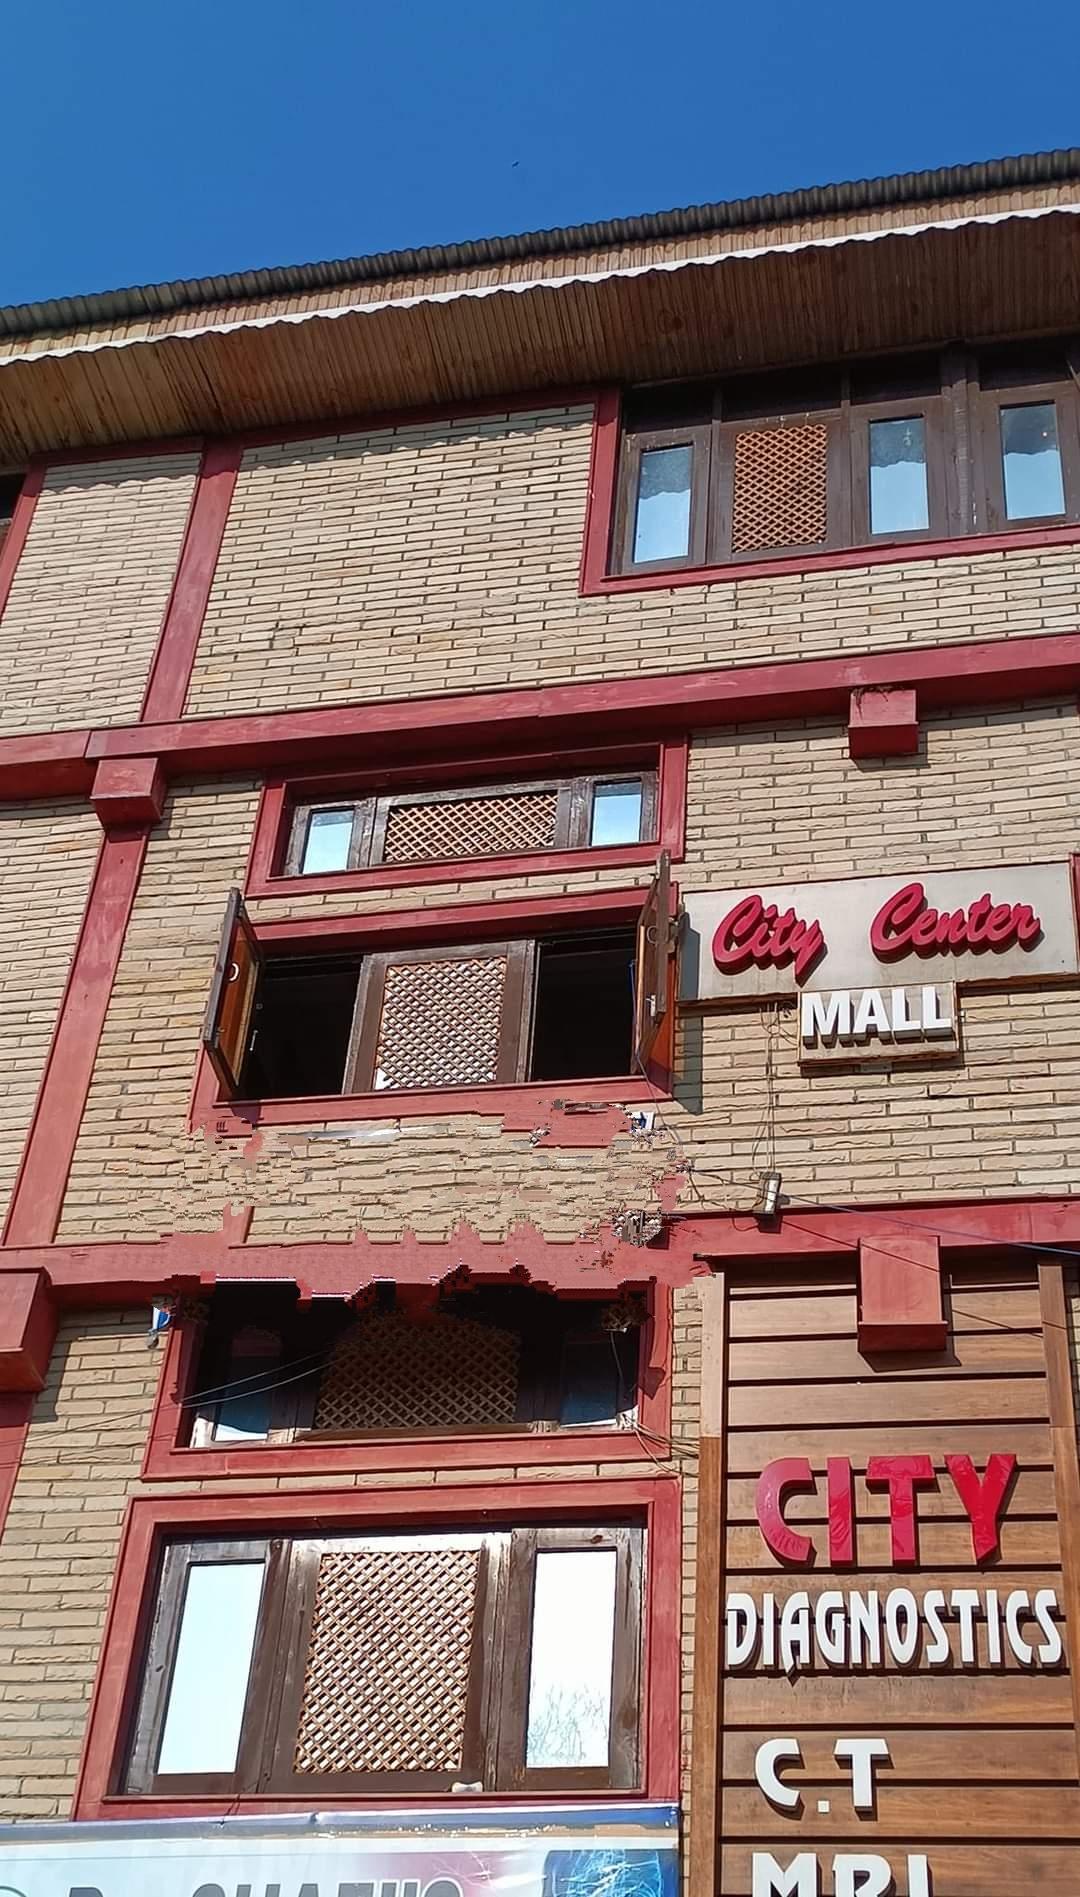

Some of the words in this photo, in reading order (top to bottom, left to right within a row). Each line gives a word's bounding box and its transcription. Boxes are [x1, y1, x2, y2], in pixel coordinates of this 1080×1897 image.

[712, 894, 825, 985] City
[870, 882, 1042, 963] Center
[801, 985, 954, 1043] MALL
[755, 1454, 1017, 1565] CITY
[726, 1587, 1063, 1676] DIAGNOSTICS
[754, 1737, 892, 1815] C.T
[752, 1852, 929, 1897] MRI
